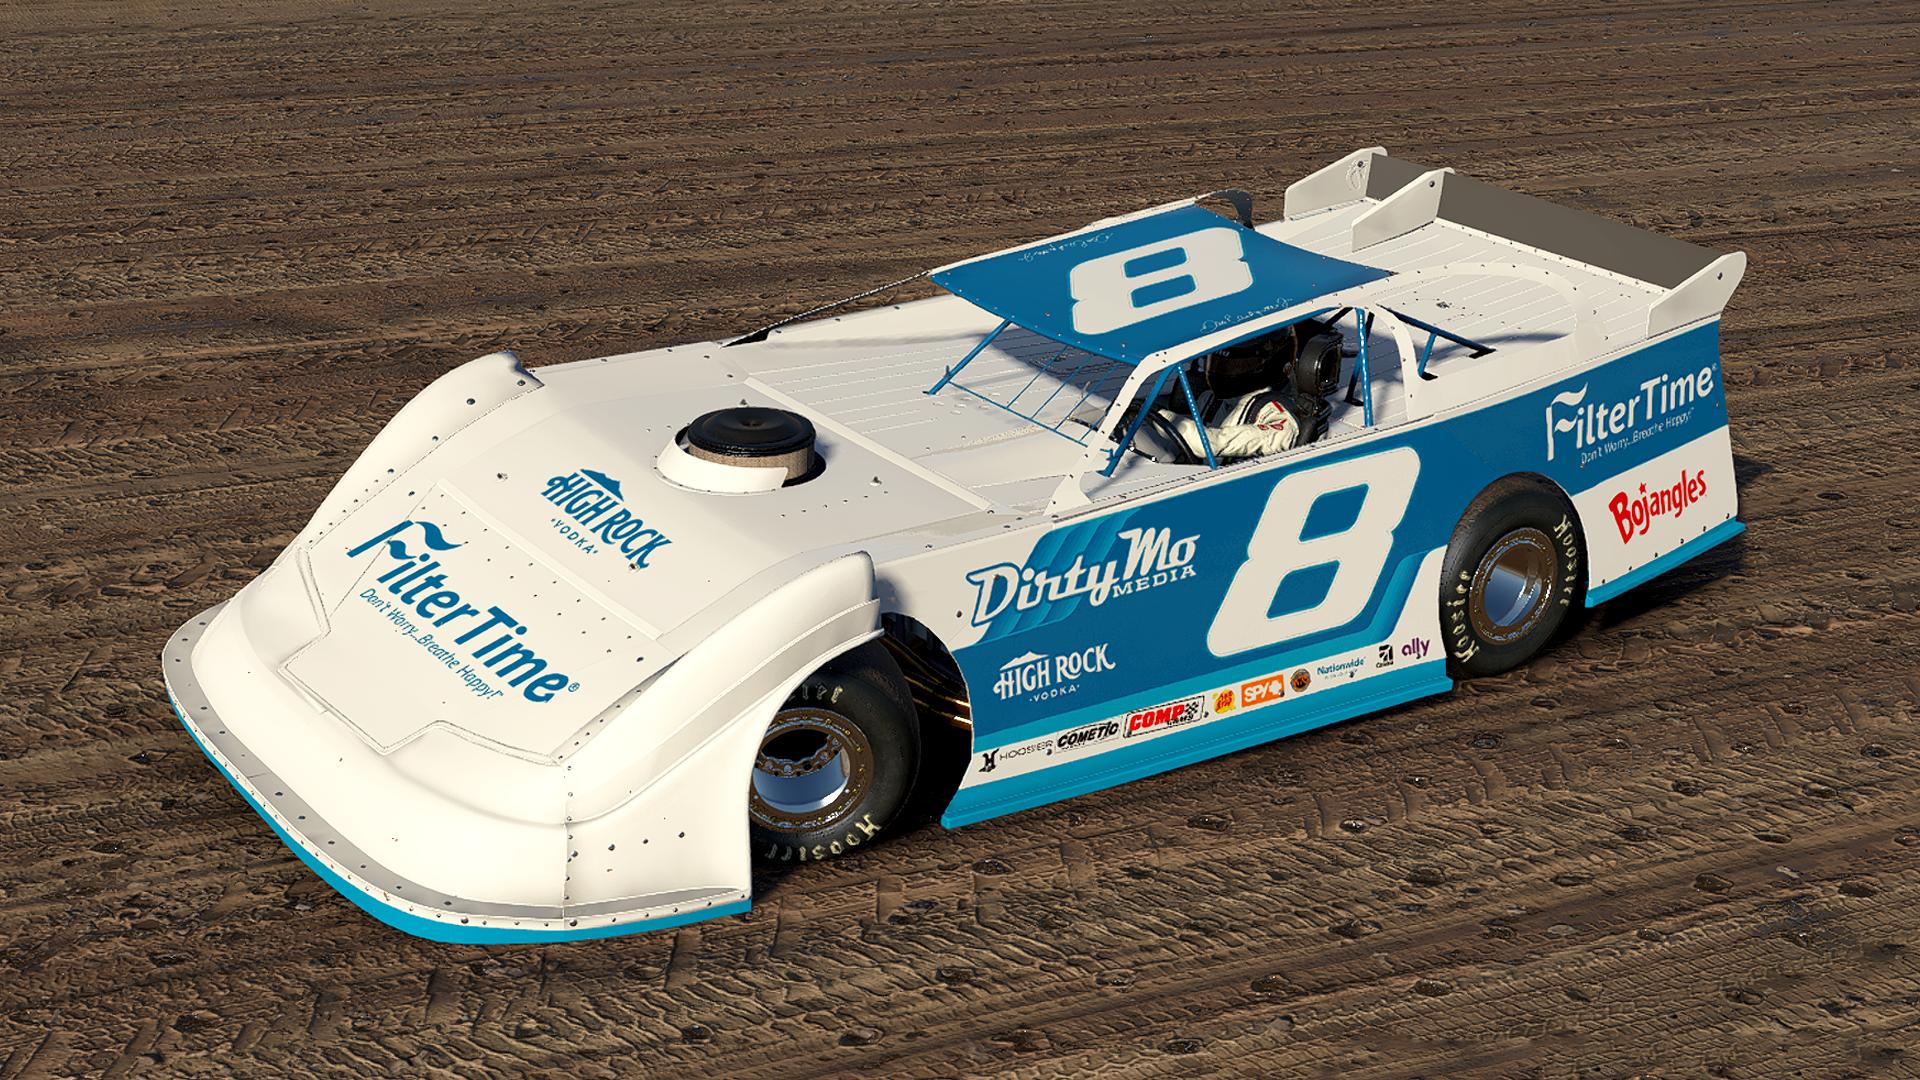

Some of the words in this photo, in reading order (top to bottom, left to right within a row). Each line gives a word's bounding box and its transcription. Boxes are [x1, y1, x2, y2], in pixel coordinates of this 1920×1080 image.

[1069, 227, 1254, 335] 8
[541, 472, 622, 525] HIGH
[597, 506, 673, 570] ROCK
[1609, 469, 1707, 544] Bojangles
[1207, 446, 1421, 658] 8
[966, 556, 1121, 626] Dirty
[1112, 565, 1197, 598] MEDIA
[360, 588, 391, 613] Don't
[1401, 638, 1430, 657] ally
[993, 659, 1050, 700] HIGH
[1055, 643, 1117, 682] ROCK
[1317, 658, 1364, 675] Nationwide
[1033, 685, 1076, 702] VODKA
[1130, 704, 1185, 731] COMP
[1000, 740, 1053, 760] HOOSIER
